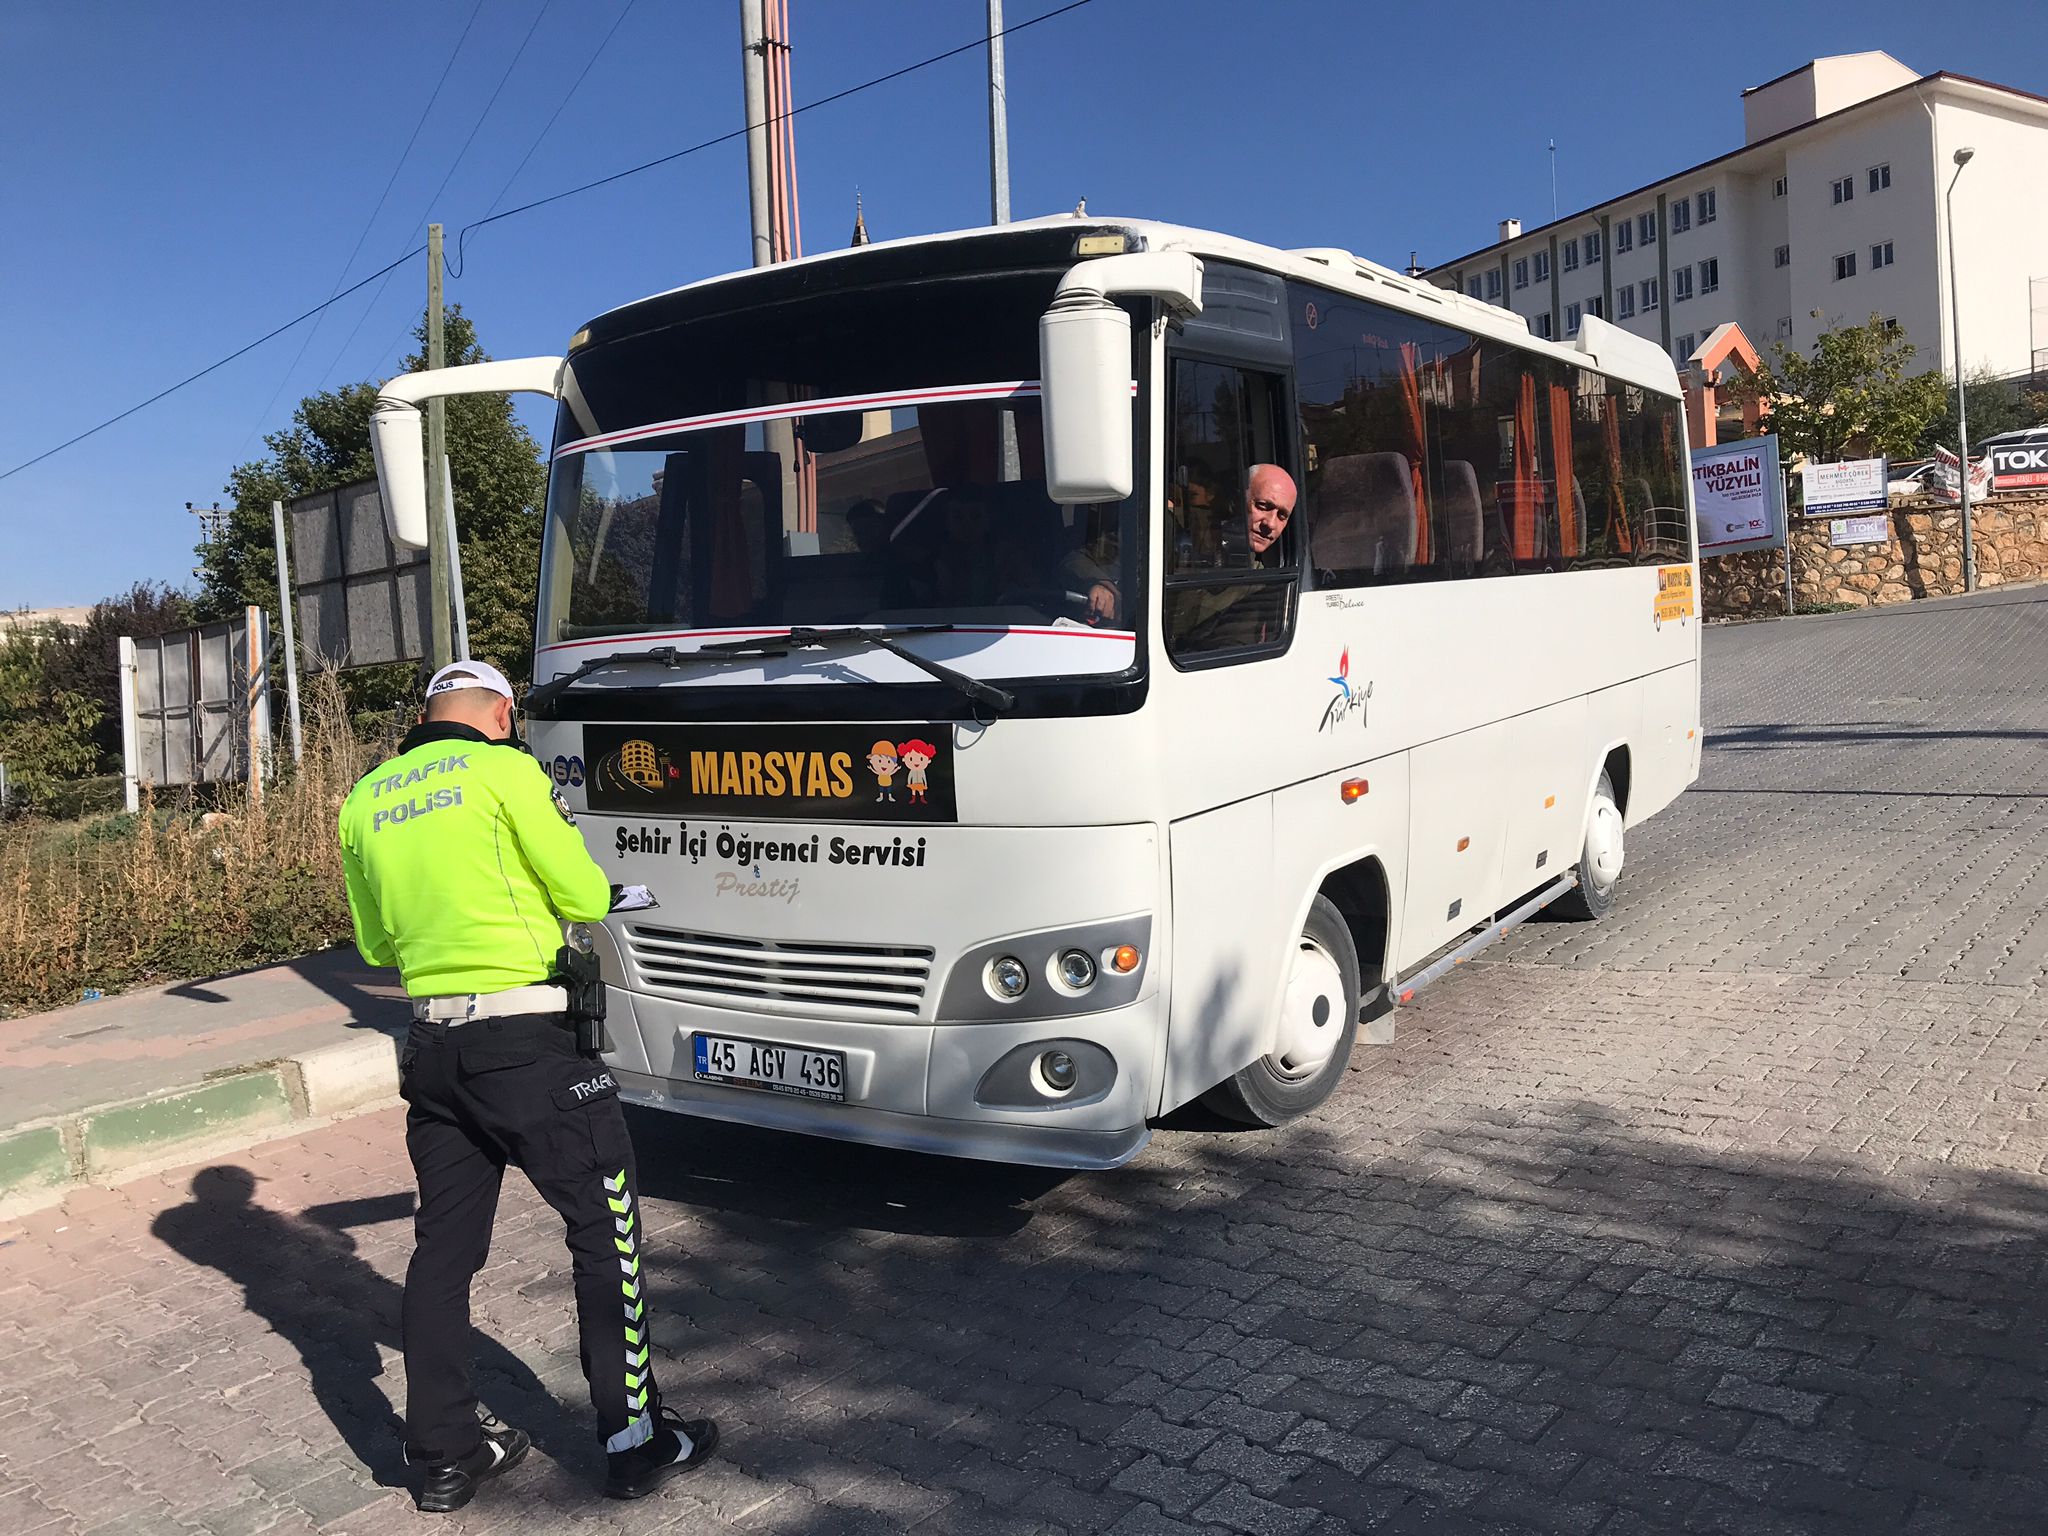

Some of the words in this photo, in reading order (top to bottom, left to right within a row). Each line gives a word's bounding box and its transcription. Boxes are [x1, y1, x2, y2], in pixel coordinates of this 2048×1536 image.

[1706, 473, 1761, 493] YÜZYILI
[1319, 681, 1373, 735] Türkiye
[690, 751, 854, 798] MARSYAS
[373, 786, 463, 833] POLİSİ
[615, 826, 672, 859] Şehir
[679, 821, 707, 865] İçi
[716, 824, 819, 867] Öğrenci
[828, 836, 926, 867] Servisi
[714, 871, 801, 904] Prestij
[697, 1055, 708, 1065] TR
[711, 1042, 736, 1072] 45
[749, 1048, 786, 1080] AGV
[800, 1054, 841, 1088] 436
